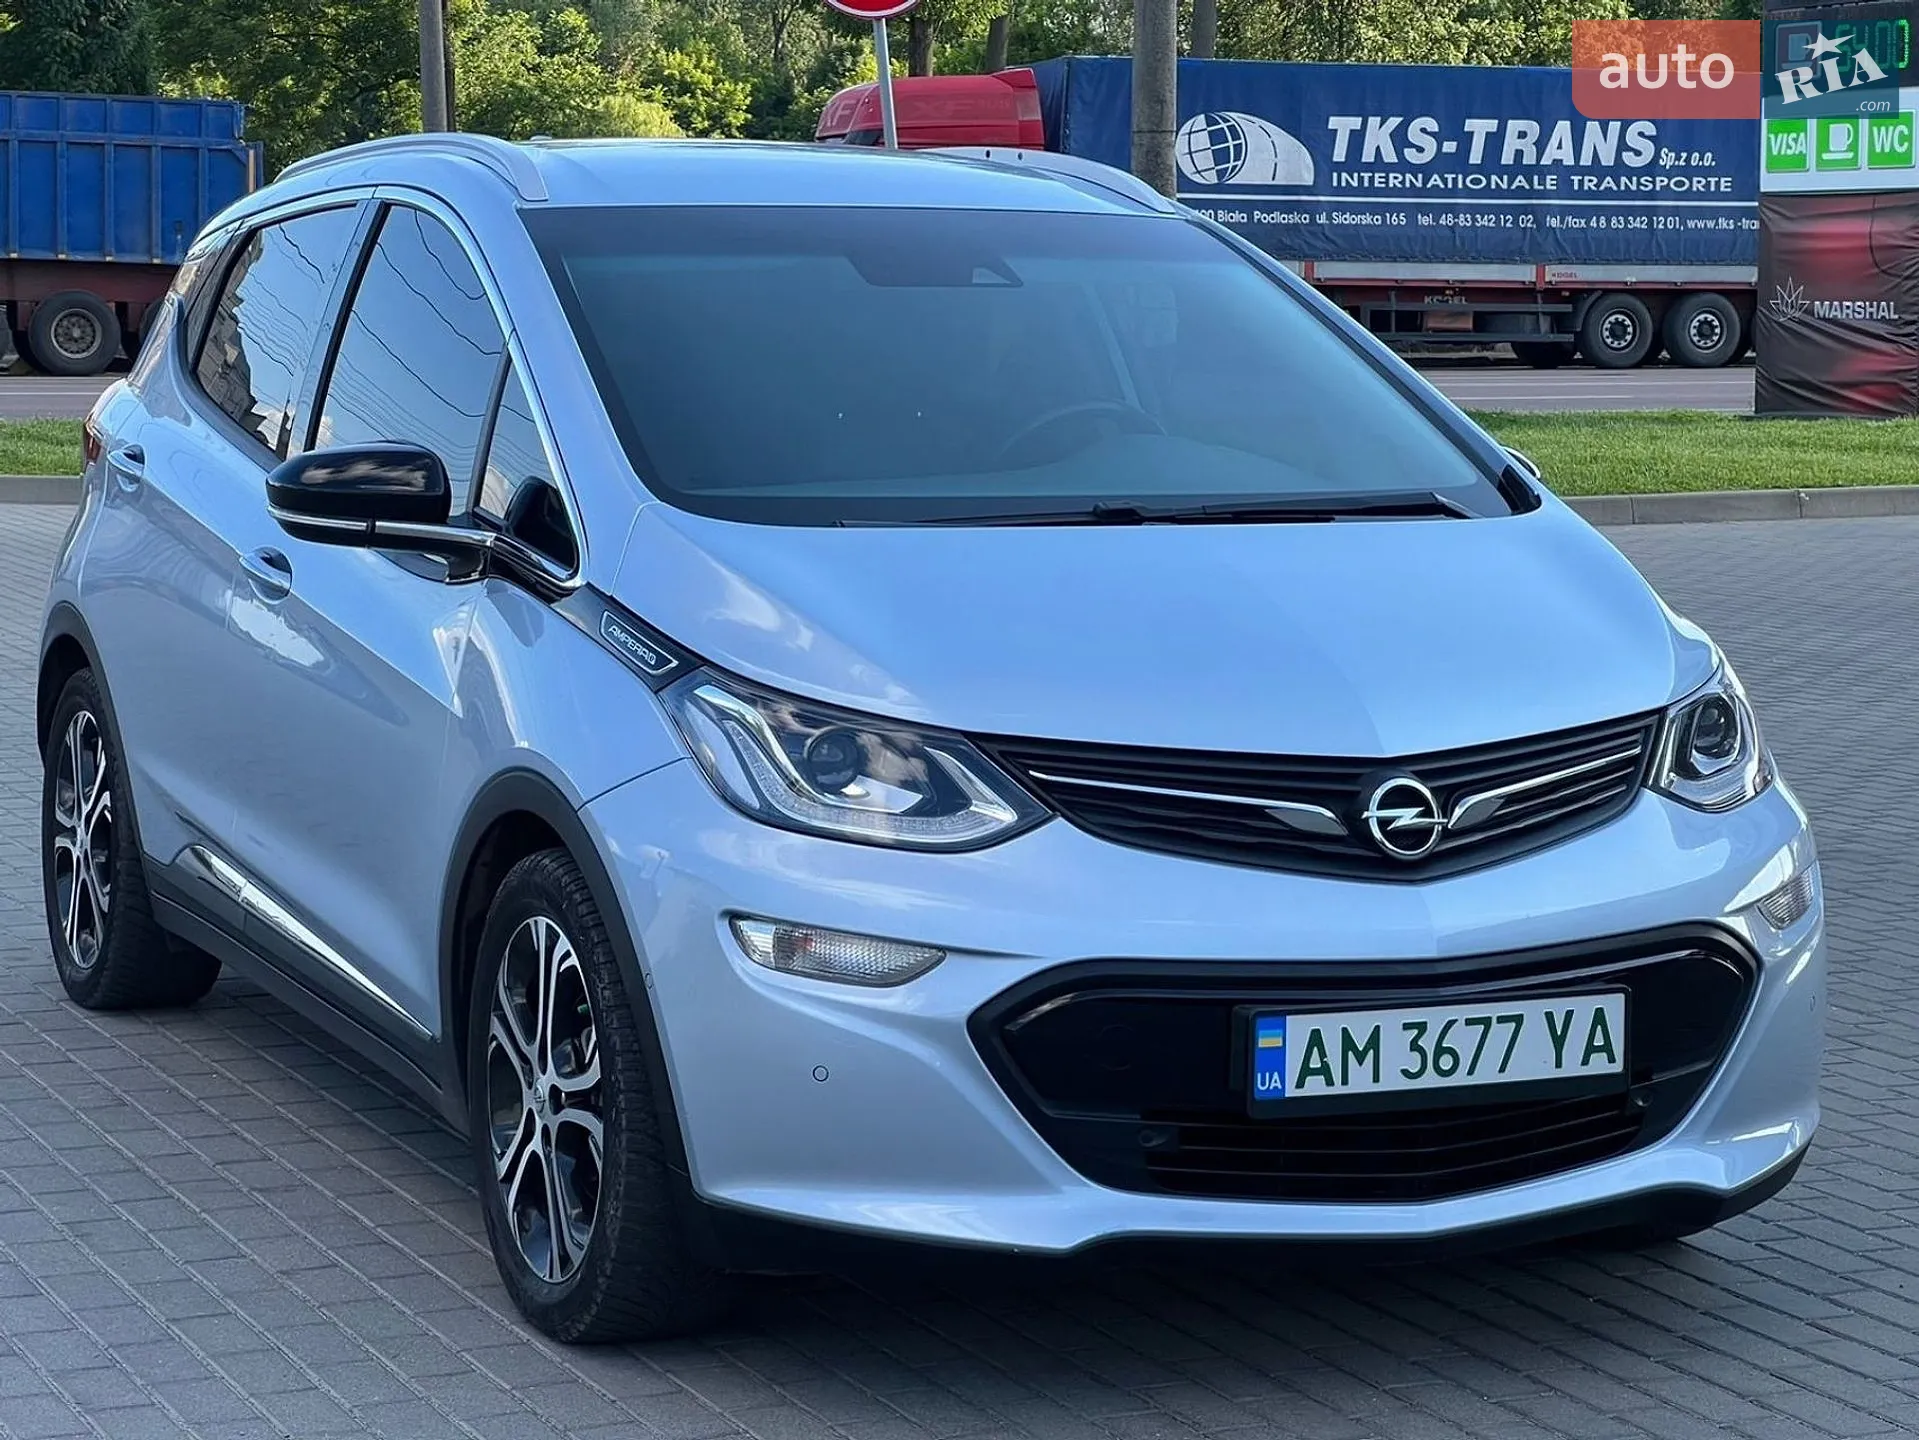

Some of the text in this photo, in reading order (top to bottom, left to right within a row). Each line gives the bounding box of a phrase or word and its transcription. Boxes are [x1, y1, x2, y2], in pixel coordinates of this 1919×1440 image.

[1327, 116, 1657, 167] TKS-TRANS
[1691, 152, 1716, 166] o.o.
[1769, 132, 1807, 156] VISA
[1873, 124, 1909, 153] WC
[1332, 171, 1733, 192] INTERNATIONALE TRANSPORTE
[1253, 210, 1310, 223] Podlaska
[1316, 212, 1329, 224] ul.
[1332, 211, 1382, 225] Sidorska
[1385, 212, 1407, 226] 165
[1417, 213, 1436, 226] tel.
[1439, 213, 1472, 227] 48-83
[1474, 214, 1496, 227] 342
[1500, 214, 1514, 228] 12
[1519, 214, 1537, 229] 02,
[1610, 216, 1625, 229] 83
[1627, 216, 1648, 229] 342
[1814, 300, 1899, 320] MARSHAL
[1295, 1006, 1617, 1090] AM 3677 YA
[1257, 1072, 1282, 1091] UA
